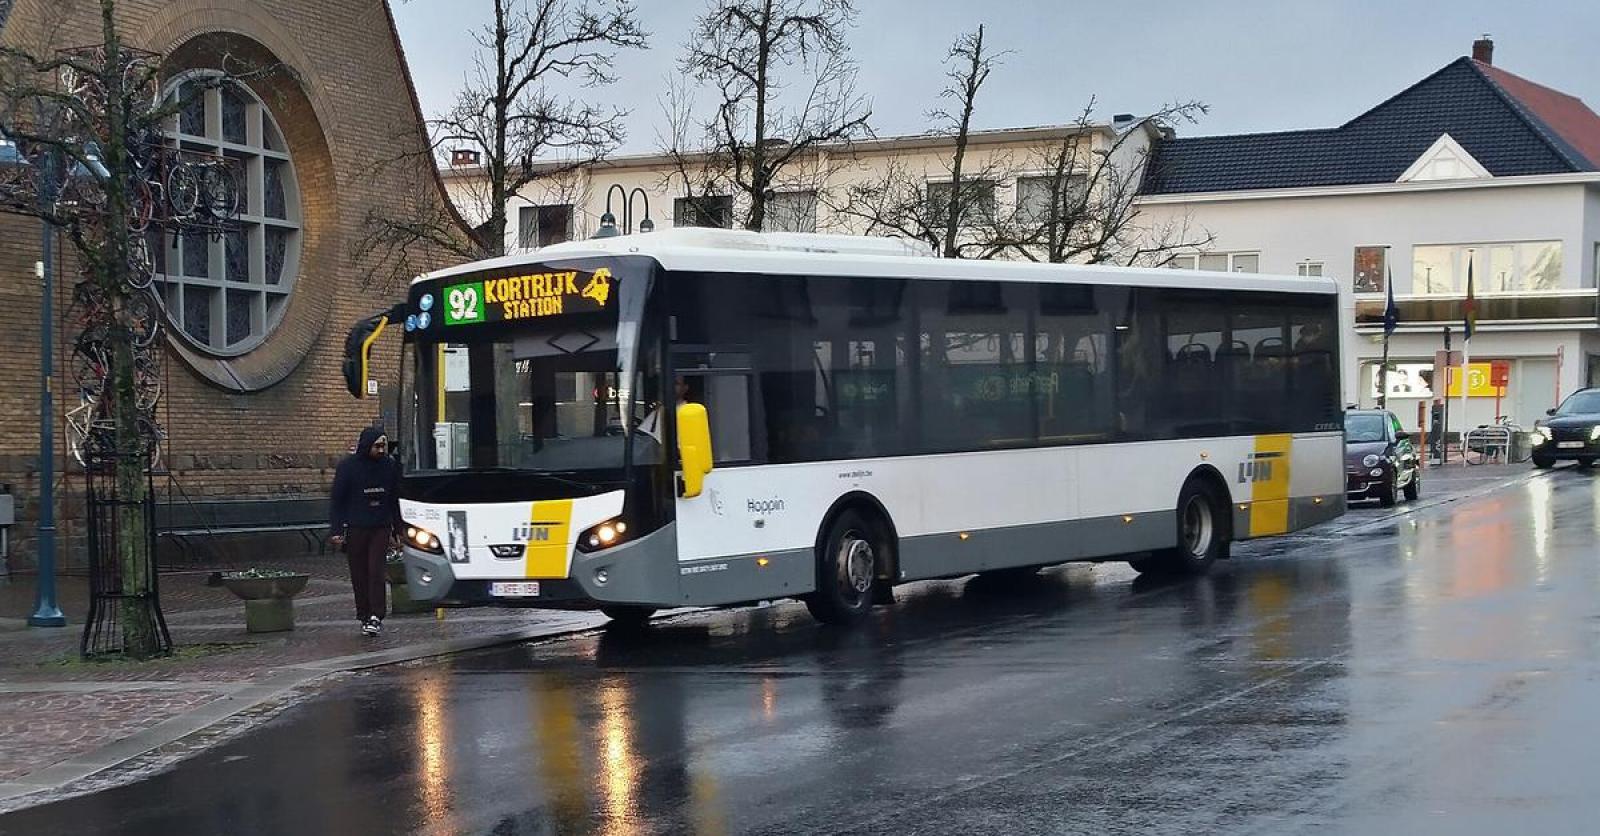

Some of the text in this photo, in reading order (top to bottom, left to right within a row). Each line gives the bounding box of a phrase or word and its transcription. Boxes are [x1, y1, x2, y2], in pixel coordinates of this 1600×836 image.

[449, 272, 579, 320] 92 KORTRIJK
[503, 296, 563, 320] STATION
[747, 495, 785, 515] Hoppin
